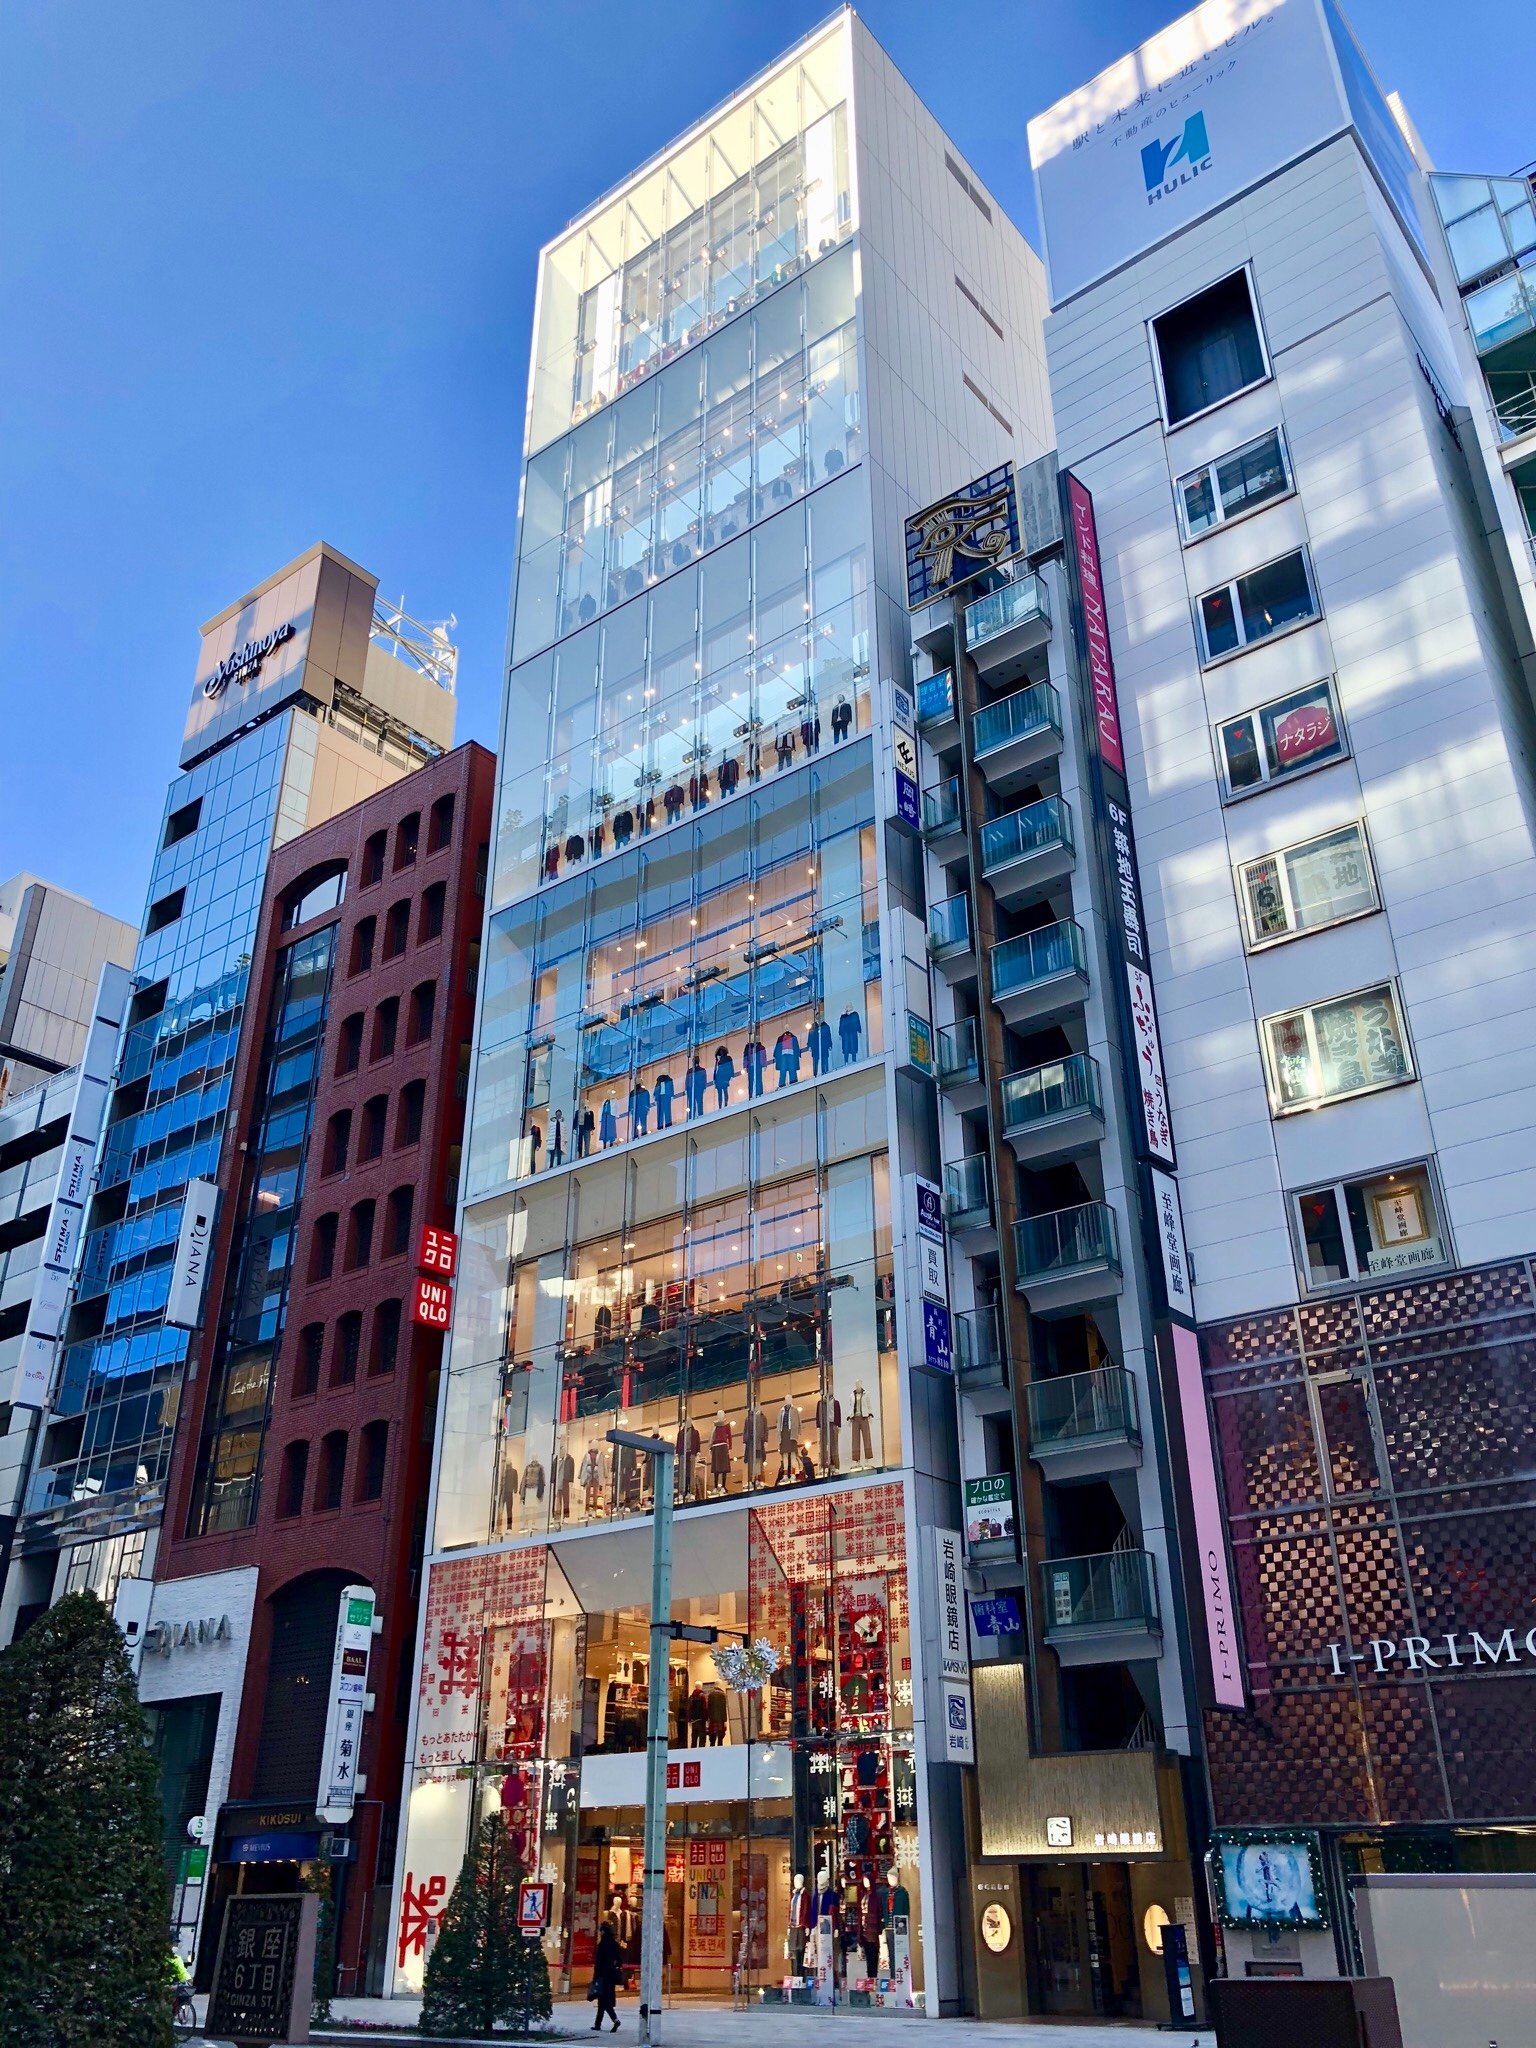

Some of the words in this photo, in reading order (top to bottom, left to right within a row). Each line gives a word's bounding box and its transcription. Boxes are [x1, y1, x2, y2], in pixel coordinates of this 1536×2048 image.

[1147, 156, 1213, 206] HULIC
[1085, 592, 1118, 748] NATARAJ
[1279, 717, 1332, 751] ナタラジ
[897, 760, 915, 780] NEXUS
[1108, 802, 1127, 827] 6F
[1134, 970, 1143, 982] 5F
[1143, 1087, 1159, 1149] 焼き鳥
[1155, 1088, 1168, 1147] うなぎ
[68, 1155, 82, 1198] SHIMA
[1394, 1199, 1410, 1238] 至峰堂画廊
[54, 1219, 69, 1263] SHIMA
[185, 1215, 209, 1286] DIANA
[426, 1231, 453, 1252] ユニ
[1161, 1190, 1184, 1295] 至峰堂画廊
[424, 1248, 452, 1270] クロ
[928, 1248, 939, 1286] 買取
[1367, 1246, 1436, 1274] 至峰堂画廊
[421, 1283, 447, 1305] UNI
[419, 1301, 447, 1323] QLO
[926, 1315, 948, 1356] 青山
[970, 1492, 1006, 1504] 確かな鑑定で
[971, 1478, 1005, 1494] プロの
[943, 1538, 960, 1651] 岩崎眼鏡店
[987, 1614, 1020, 1635] 青山
[1208, 1550, 1232, 1680] I-PRIMO
[142, 1614, 232, 1660] DIANA
[346, 1656, 362, 1664] BAAL
[949, 1734, 964, 1749] 岩崎
[337, 1739, 353, 1780] 菊水
[685, 1765, 698, 1774] UNI
[685, 1775, 699, 1785] QLO
[197, 1818, 203, 1829] 5
[711, 1844, 723, 1852] UNI
[711, 1853, 724, 1862] QLO
[689, 1868, 726, 1881] UNIQLO
[689, 1883, 726, 1900] GINZA
[237, 1927, 282, 1959] 銀座
[234, 1964, 275, 1991] 6丁目
[230, 1995, 257, 2007] GINZA
